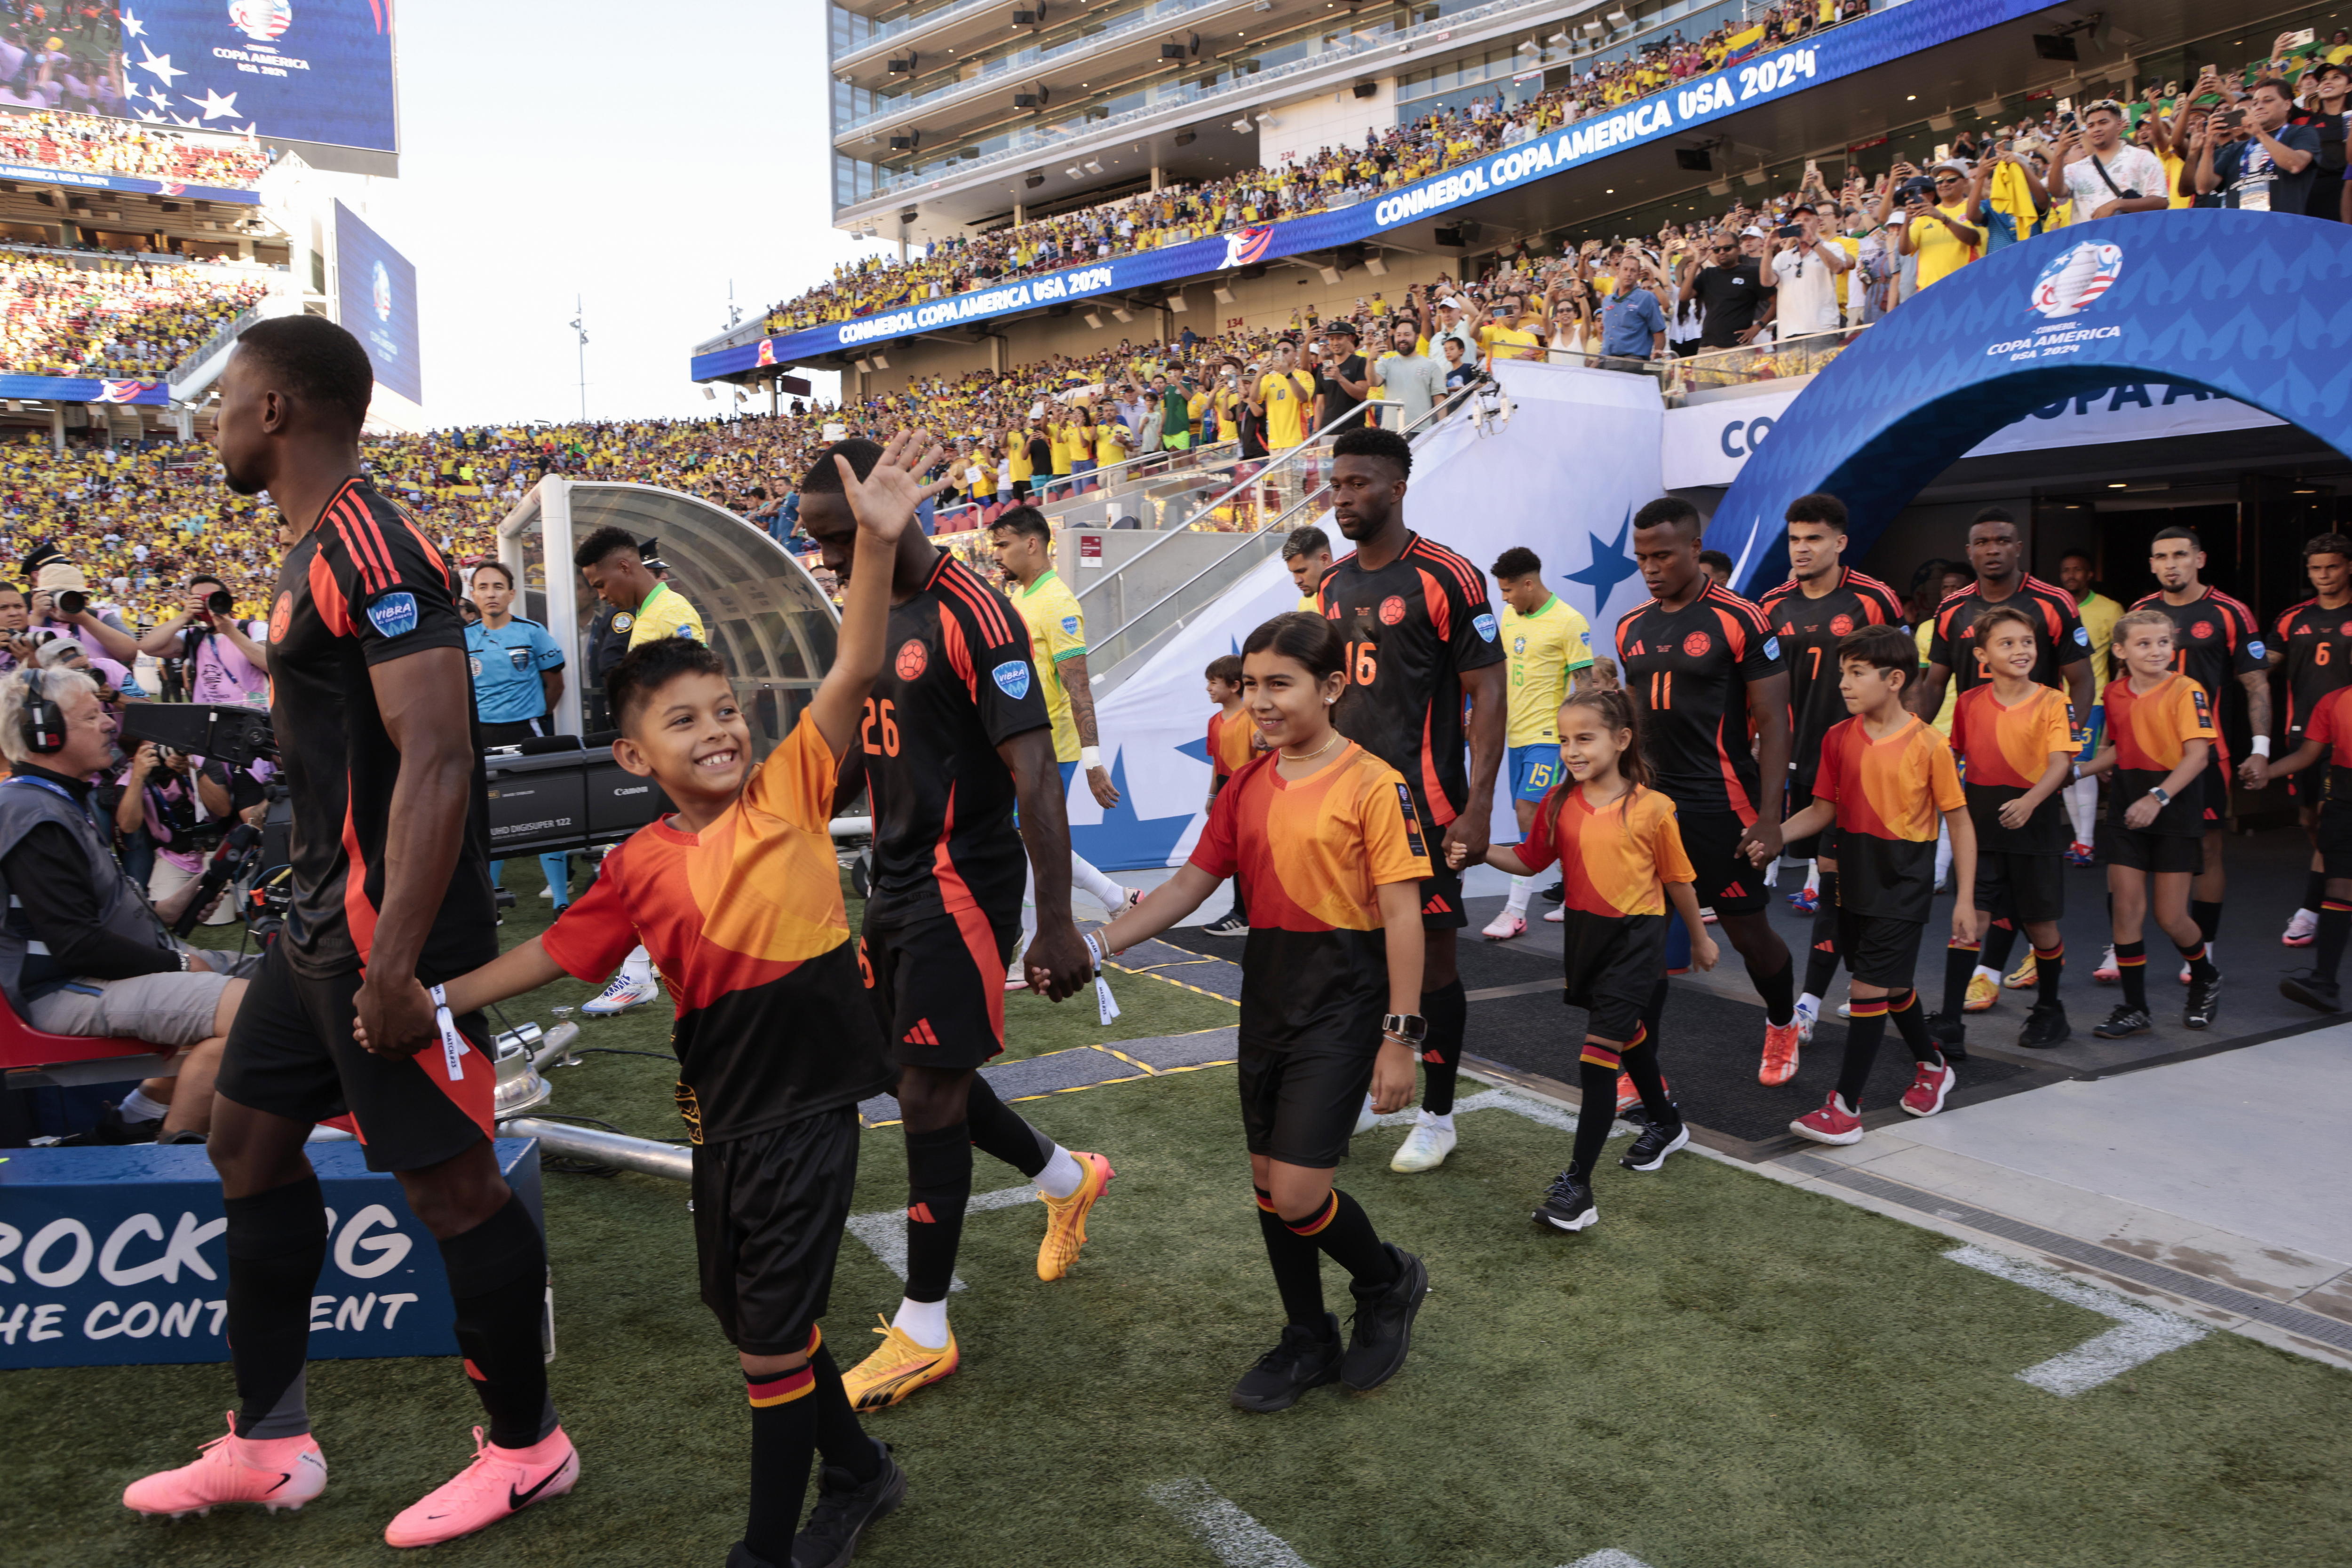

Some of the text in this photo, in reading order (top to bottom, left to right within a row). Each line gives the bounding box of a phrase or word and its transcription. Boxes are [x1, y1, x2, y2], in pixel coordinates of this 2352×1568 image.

[213, 48, 250, 62] COPA
[250, 53, 310, 70] AMERICA
[1375, 49, 1816, 226] CONMEBOL COPA AMERICA USA 2024
[1280, 150, 1295, 161] 234
[839, 267, 1112, 344] CONMEBOL COPA AMERICA USA 2024
[1227, 317, 1243, 328] 134
[1986, 325, 2121, 356] COPA AMERICA
[2010, 344, 2080, 361] USA 2024
[375, 603, 412, 620] VIBRA
[1345, 641, 1377, 686] 16
[1807, 647, 1821, 680] 7
[2315, 641, 2330, 666] 6
[999, 668, 1025, 682] VIBRA
[1512, 663, 1524, 687] 15
[1651, 671, 1671, 710] 11
[861, 697, 900, 758] 26
[1529, 762, 1553, 787] 15
[613, 786, 649, 796] Canon
[490, 826, 510, 836] UHD
[510, 820, 555, 833] DIGISUPER
[555, 817, 572, 826] 122
[445, 1031, 454, 1054] MATCH
[0, 1204, 413, 1288] OCKG
[83, 1291, 419, 1340] CONTENT
